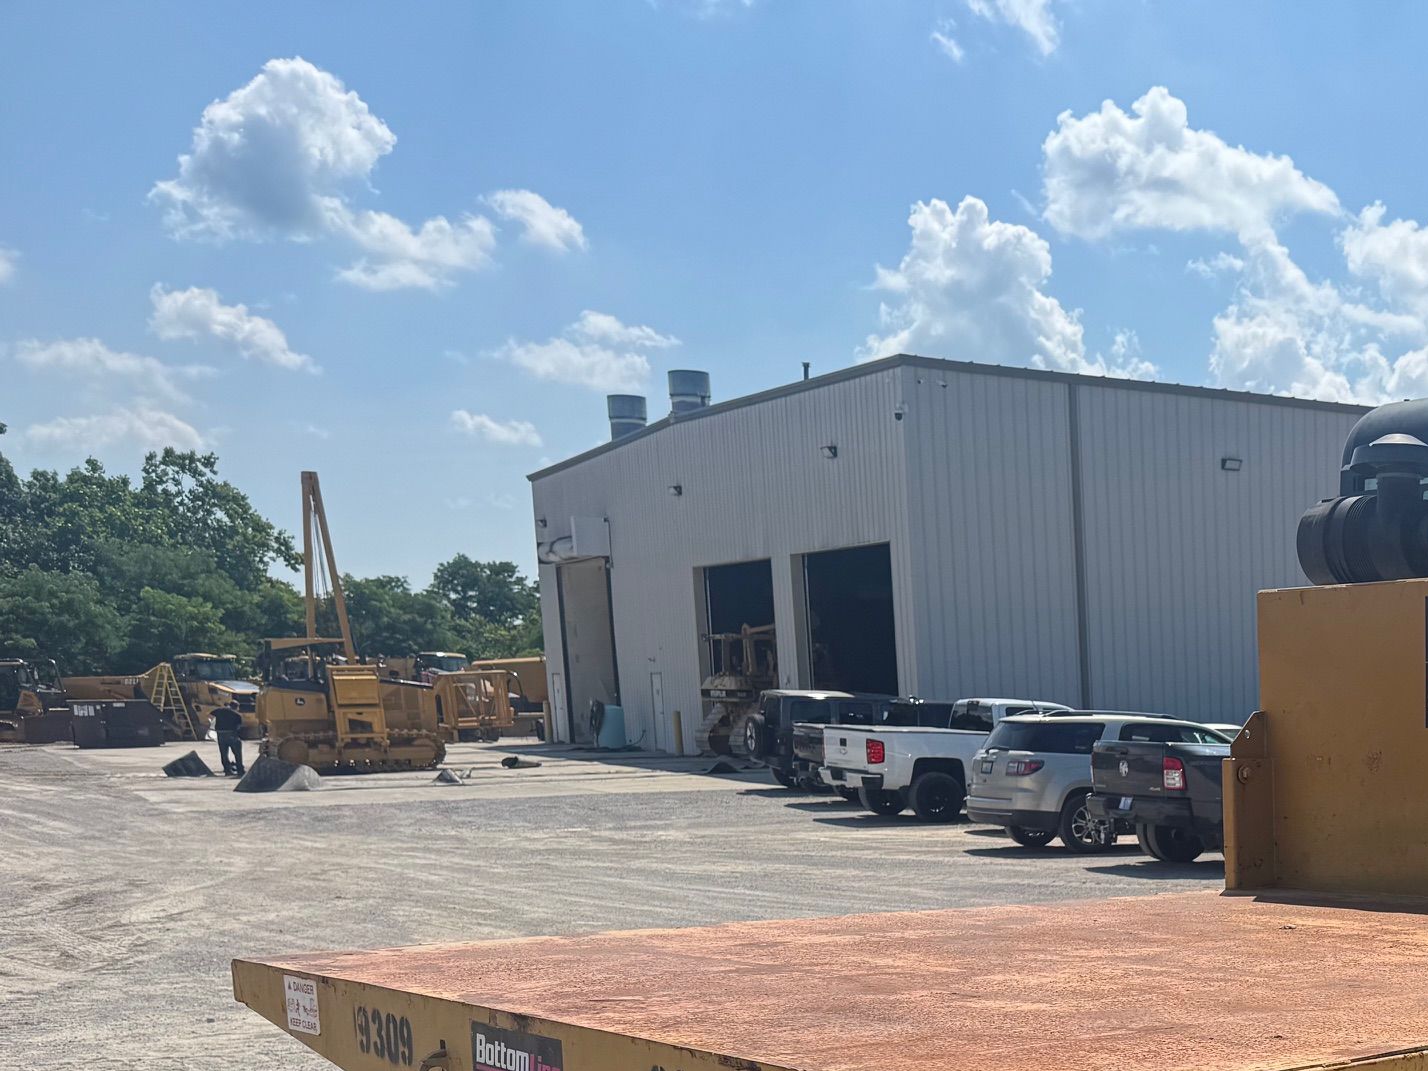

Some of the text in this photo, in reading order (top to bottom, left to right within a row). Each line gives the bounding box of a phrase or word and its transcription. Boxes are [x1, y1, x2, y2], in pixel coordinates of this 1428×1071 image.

[293, 981, 314, 995] DANGER
[290, 1017, 318, 1032] KEEP CLEAR
[354, 1005, 414, 1067] 9309
